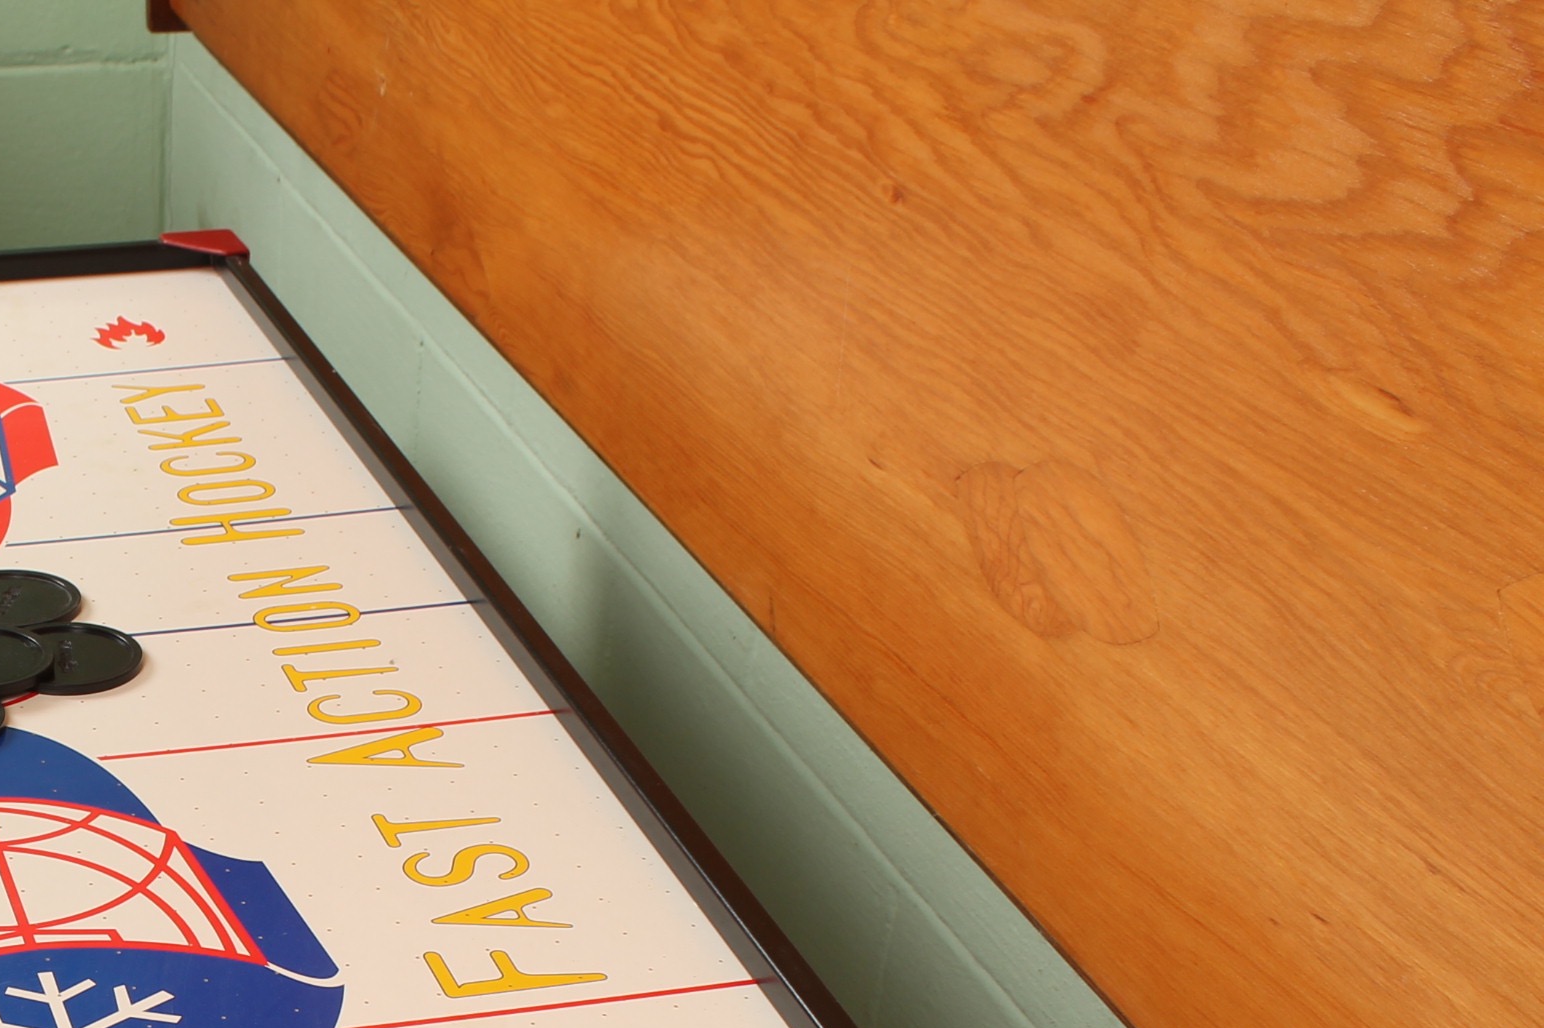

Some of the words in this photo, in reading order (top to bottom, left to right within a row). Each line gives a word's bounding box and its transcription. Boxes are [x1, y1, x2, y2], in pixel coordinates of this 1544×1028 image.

[111, 383, 305, 546] HOCKEY
[227, 565, 465, 768] ACTION
[368, 814, 608, 999] FAST
